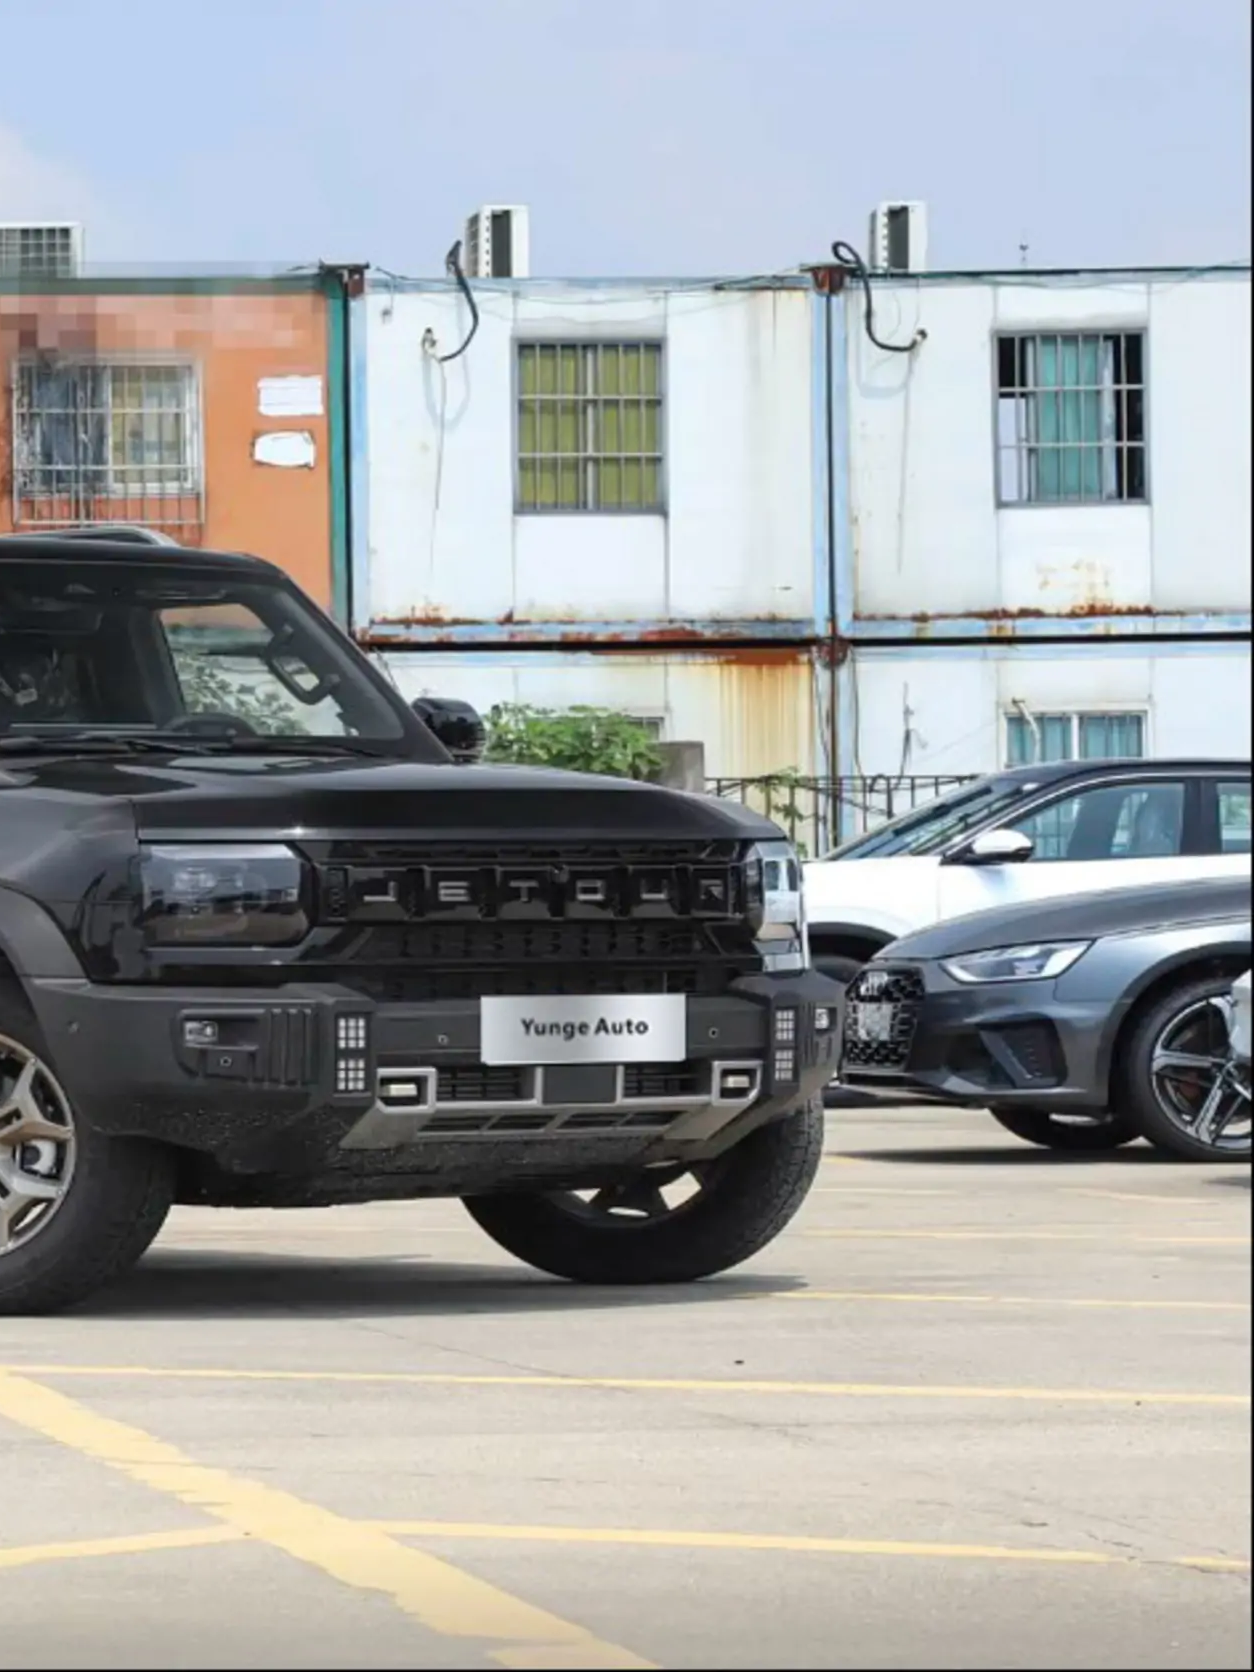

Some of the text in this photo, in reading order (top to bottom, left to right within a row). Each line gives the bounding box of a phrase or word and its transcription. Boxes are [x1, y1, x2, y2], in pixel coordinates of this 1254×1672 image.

[362, 878, 726, 903] JETOUR
[520, 1017, 649, 1042] Yunge Auto
